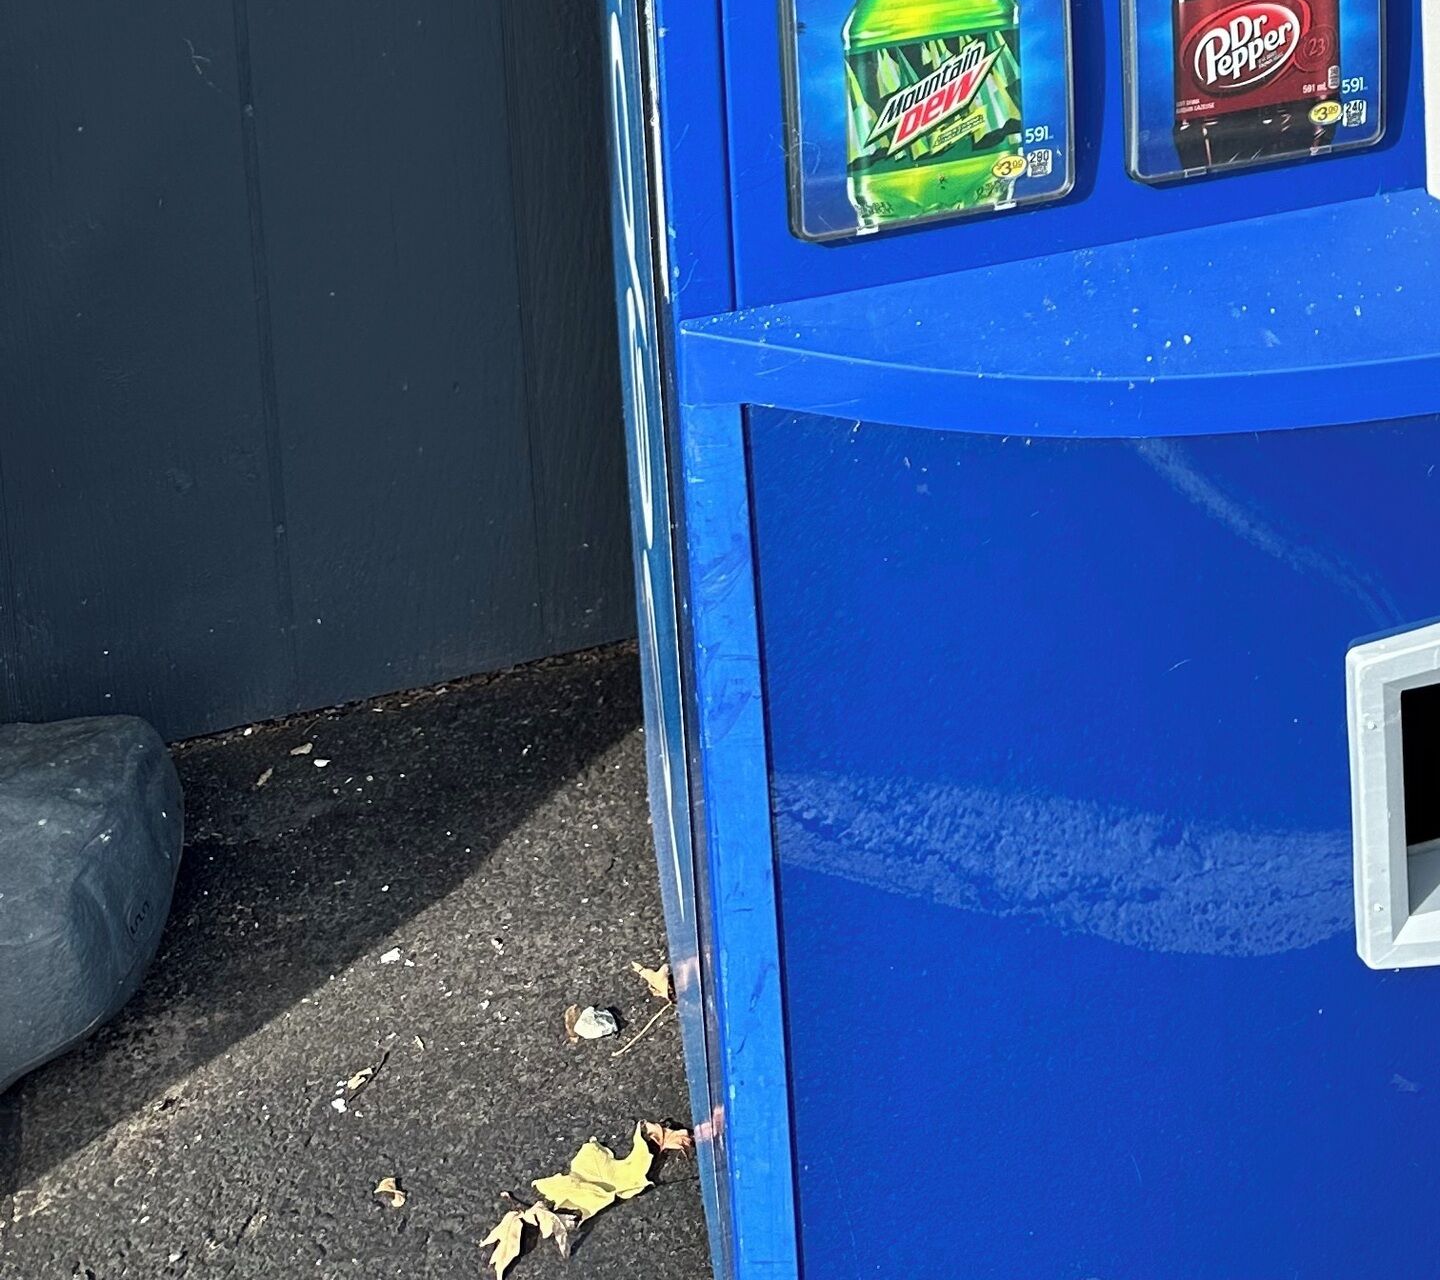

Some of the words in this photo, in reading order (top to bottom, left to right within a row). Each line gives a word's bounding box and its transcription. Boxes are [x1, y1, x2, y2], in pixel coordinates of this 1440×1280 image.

[1229, 14, 1268, 51] Dr
[1195, 22, 1292, 85] Pepper
[1309, 38, 1326, 57] 23
[878, 46, 982, 130] Mountain
[1342, 76, 1363, 94] 591
[1025, 125, 1049, 144] 591
